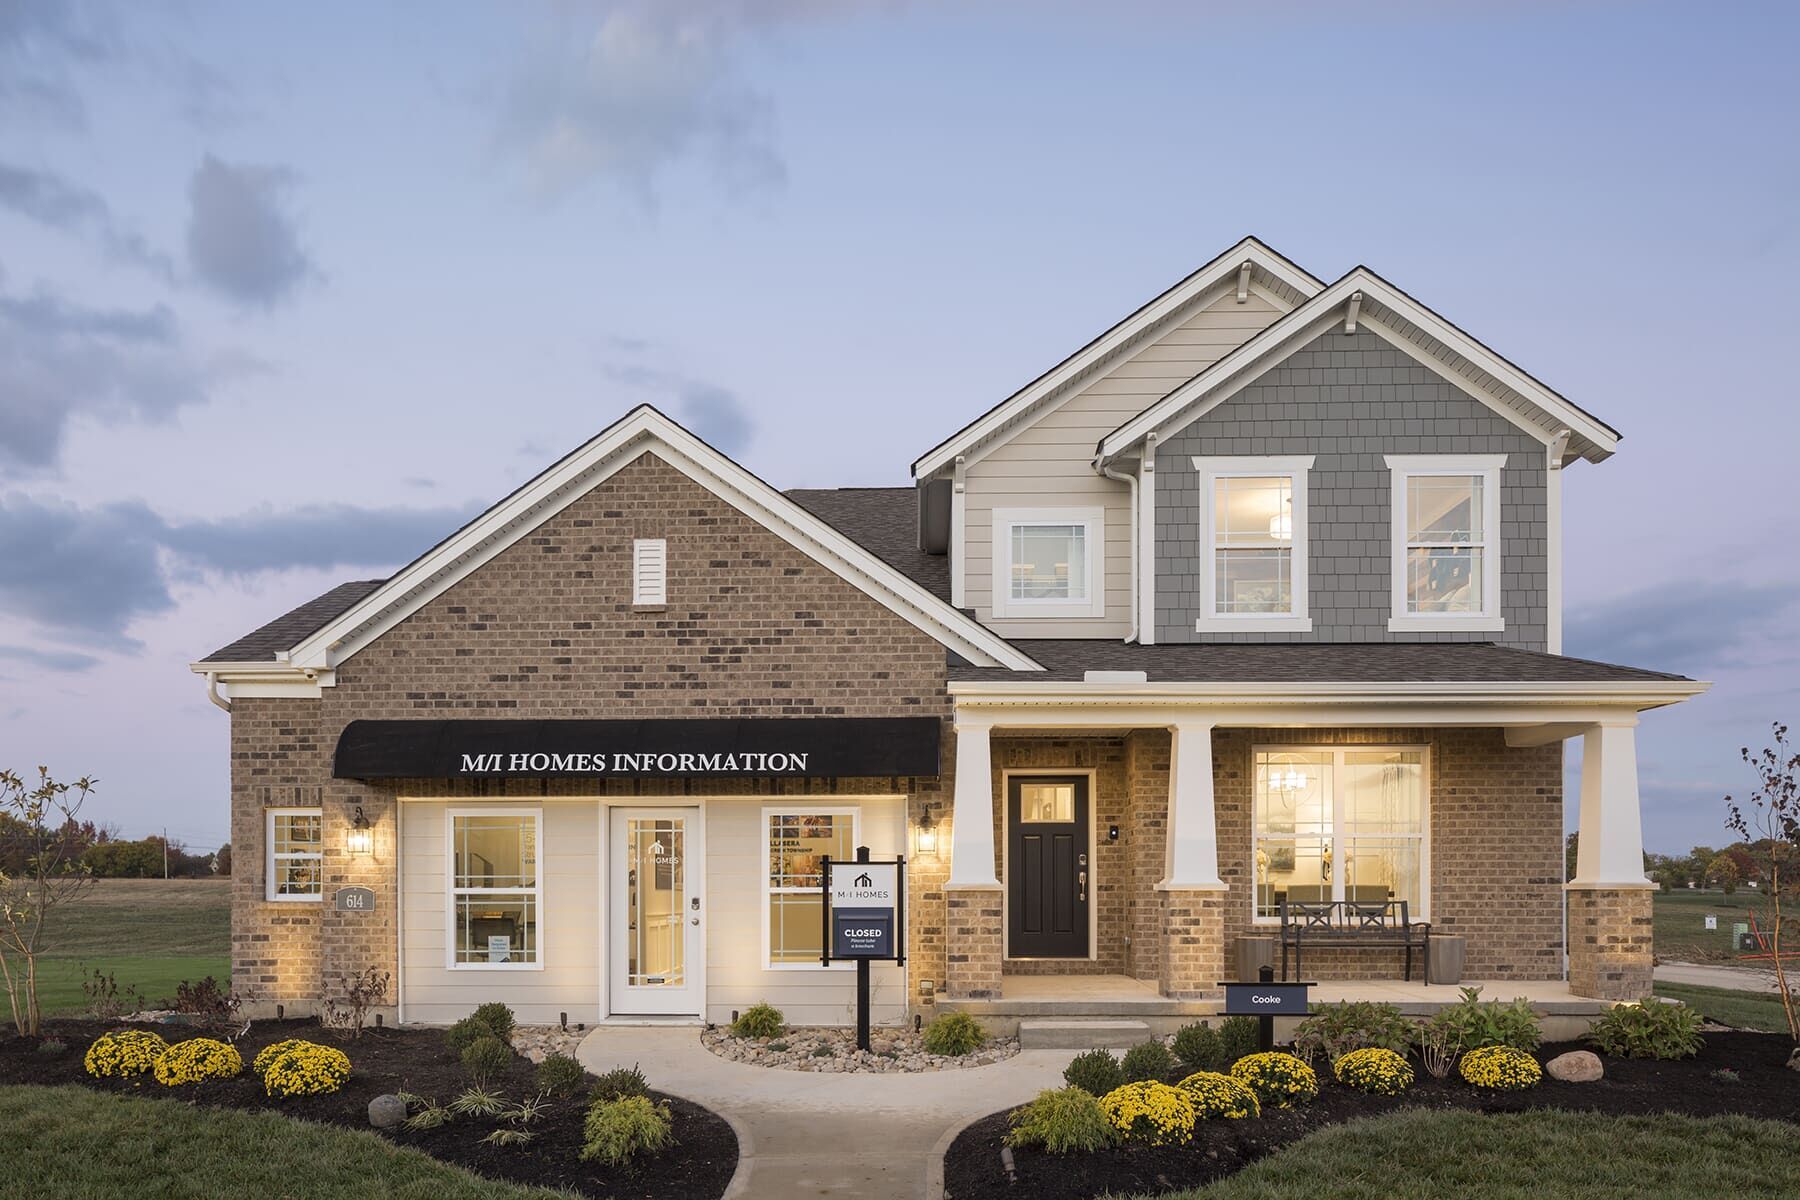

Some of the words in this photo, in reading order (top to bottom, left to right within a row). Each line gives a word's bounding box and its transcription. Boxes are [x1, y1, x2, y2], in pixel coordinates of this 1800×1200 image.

[460, 753, 503, 772] M/I
[508, 752, 606, 772] HOMES
[612, 752, 808, 772] INFORMATION
[855, 890, 889, 899] HOMES
[346, 894, 364, 908] 614
[844, 928, 882, 937] CLOSED
[1251, 995, 1281, 1004] Cooke
